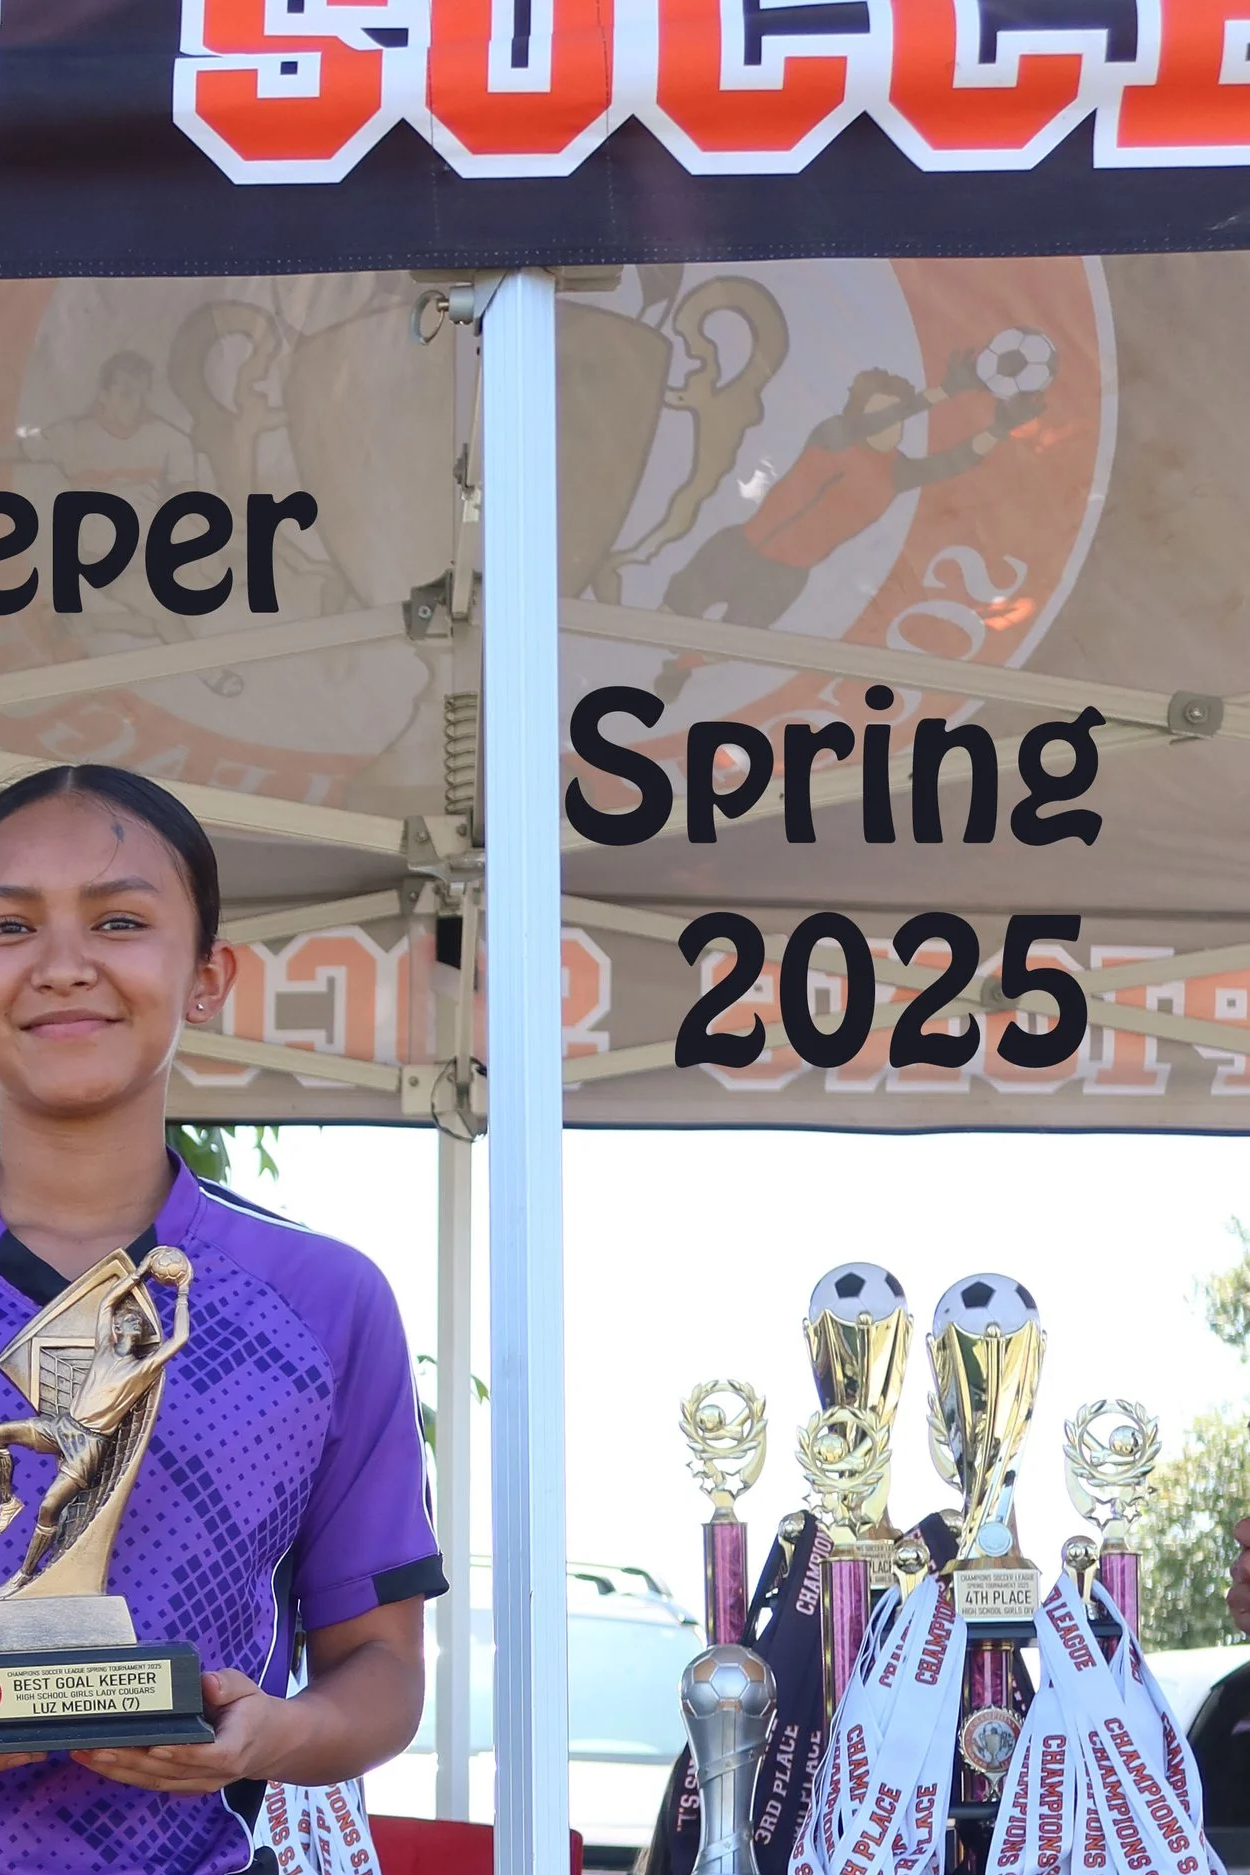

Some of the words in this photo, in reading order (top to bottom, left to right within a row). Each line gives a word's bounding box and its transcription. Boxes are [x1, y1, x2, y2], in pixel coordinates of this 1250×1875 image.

[965, 1590, 989, 1605] 4TH
[992, 1590, 1032, 1605] PLACE
[1045, 1601, 1097, 1672] LEAGUE
[7, 1670, 40, 1678] CHAMPIONS
[41, 1668, 63, 1676] SOCCER
[64, 1667, 85, 1675] LEAGUE
[109, 1664, 146, 1672] TOURNAMENT
[13, 1677, 50, 1692] BEST
[55, 1675, 94, 1690] GOAL
[99, 1672, 157, 1687] KEEPER
[16, 1693, 35, 1701] HIGH
[37, 1691, 69, 1700] SCHOOL
[70, 1690, 94, 1698] GIRLS
[96, 1689, 117, 1697] LADY
[118, 1687, 155, 1695] COUGARS
[32, 1701, 57, 1715] LUZ
[62, 1698, 117, 1713] MEDINA
[122, 1697, 140, 1711] (7)
[755, 1800, 782, 1845] 3RD
[773, 1724, 800, 1797] PLACE
[1037, 1734, 1067, 1869] CHAMPIONS
[1104, 1716, 1190, 1854] CHAMPIONS
[852, 1782, 902, 1861] PLACE
